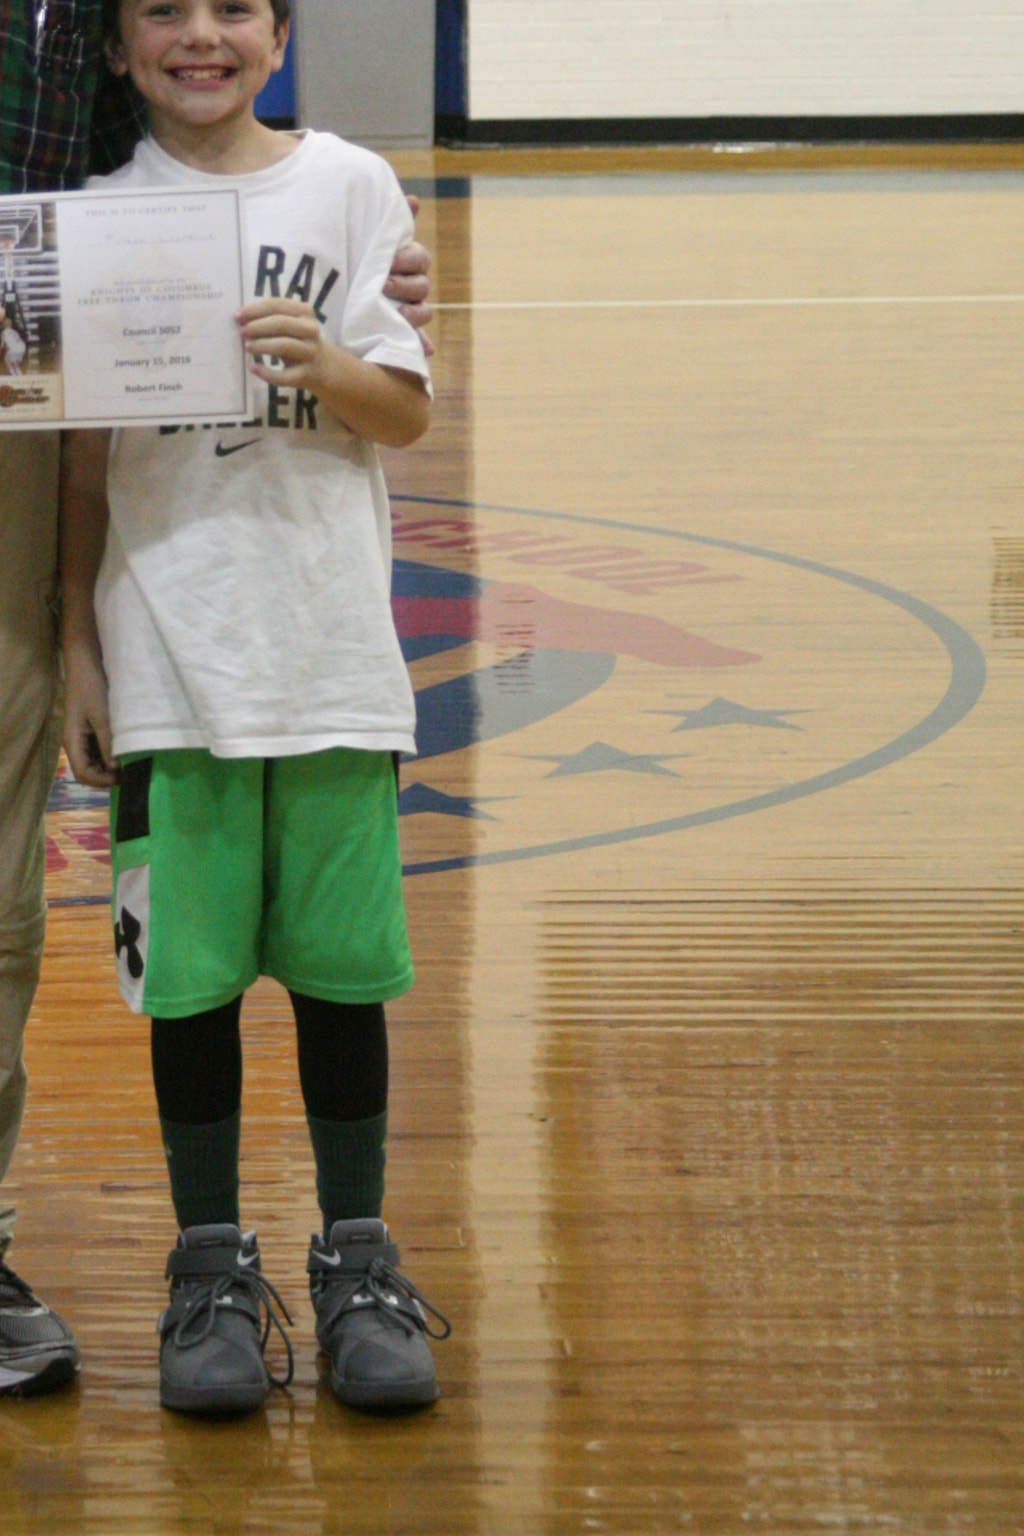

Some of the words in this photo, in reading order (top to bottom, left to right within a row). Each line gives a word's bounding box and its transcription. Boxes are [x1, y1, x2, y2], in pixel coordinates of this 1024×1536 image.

[123, 327, 156, 337] Council
[115, 357, 151, 367] January
[169, 355, 192, 365] 2016
[124, 384, 156, 393] Robert
